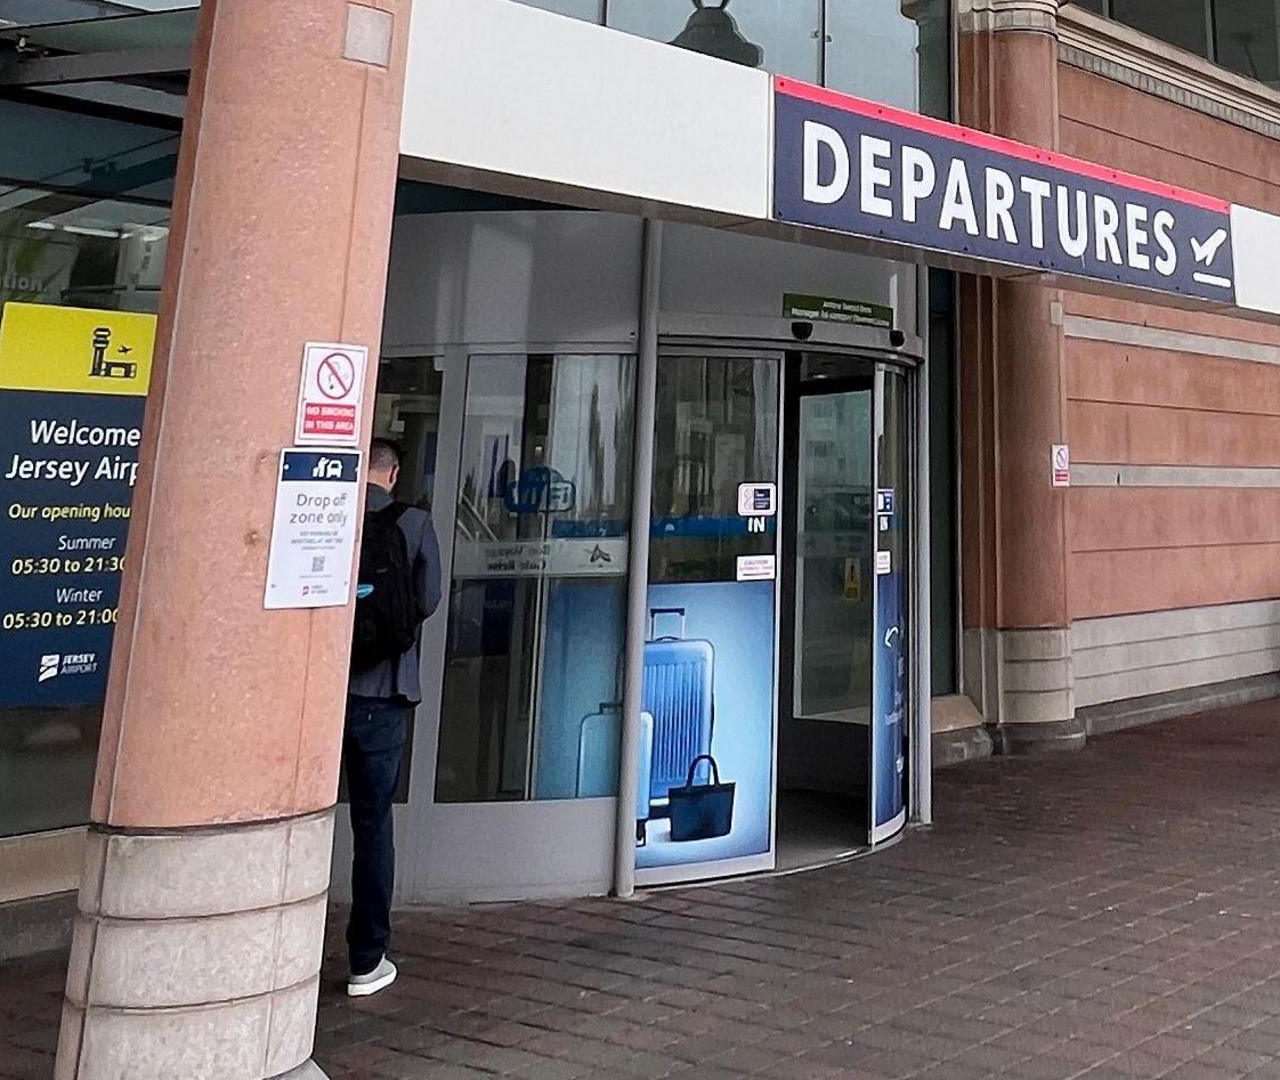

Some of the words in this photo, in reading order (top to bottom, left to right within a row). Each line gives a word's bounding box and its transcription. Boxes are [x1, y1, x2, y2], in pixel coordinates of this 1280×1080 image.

[802, 119, 1179, 277] DEPARTURES
[30, 419, 141, 447] Welcome
[5, 454, 90, 487] Jersey
[296, 493, 330, 510] Drop
[8, 503, 38, 519] Our
[41, 503, 101, 522] opening
[104, 503, 131, 518] hou
[289, 512, 324, 524] zone
[748, 518, 765, 532] IN
[58, 535, 117, 551] Summer
[11, 558, 61, 575] 05:30
[64, 559, 81, 573] to
[56, 587, 104, 604] Winter
[3, 612, 53, 629] 05:30
[55, 612, 73, 626] to
[63, 653, 96, 665] JERSEY
[60, 663, 98, 675] AIRPORT
